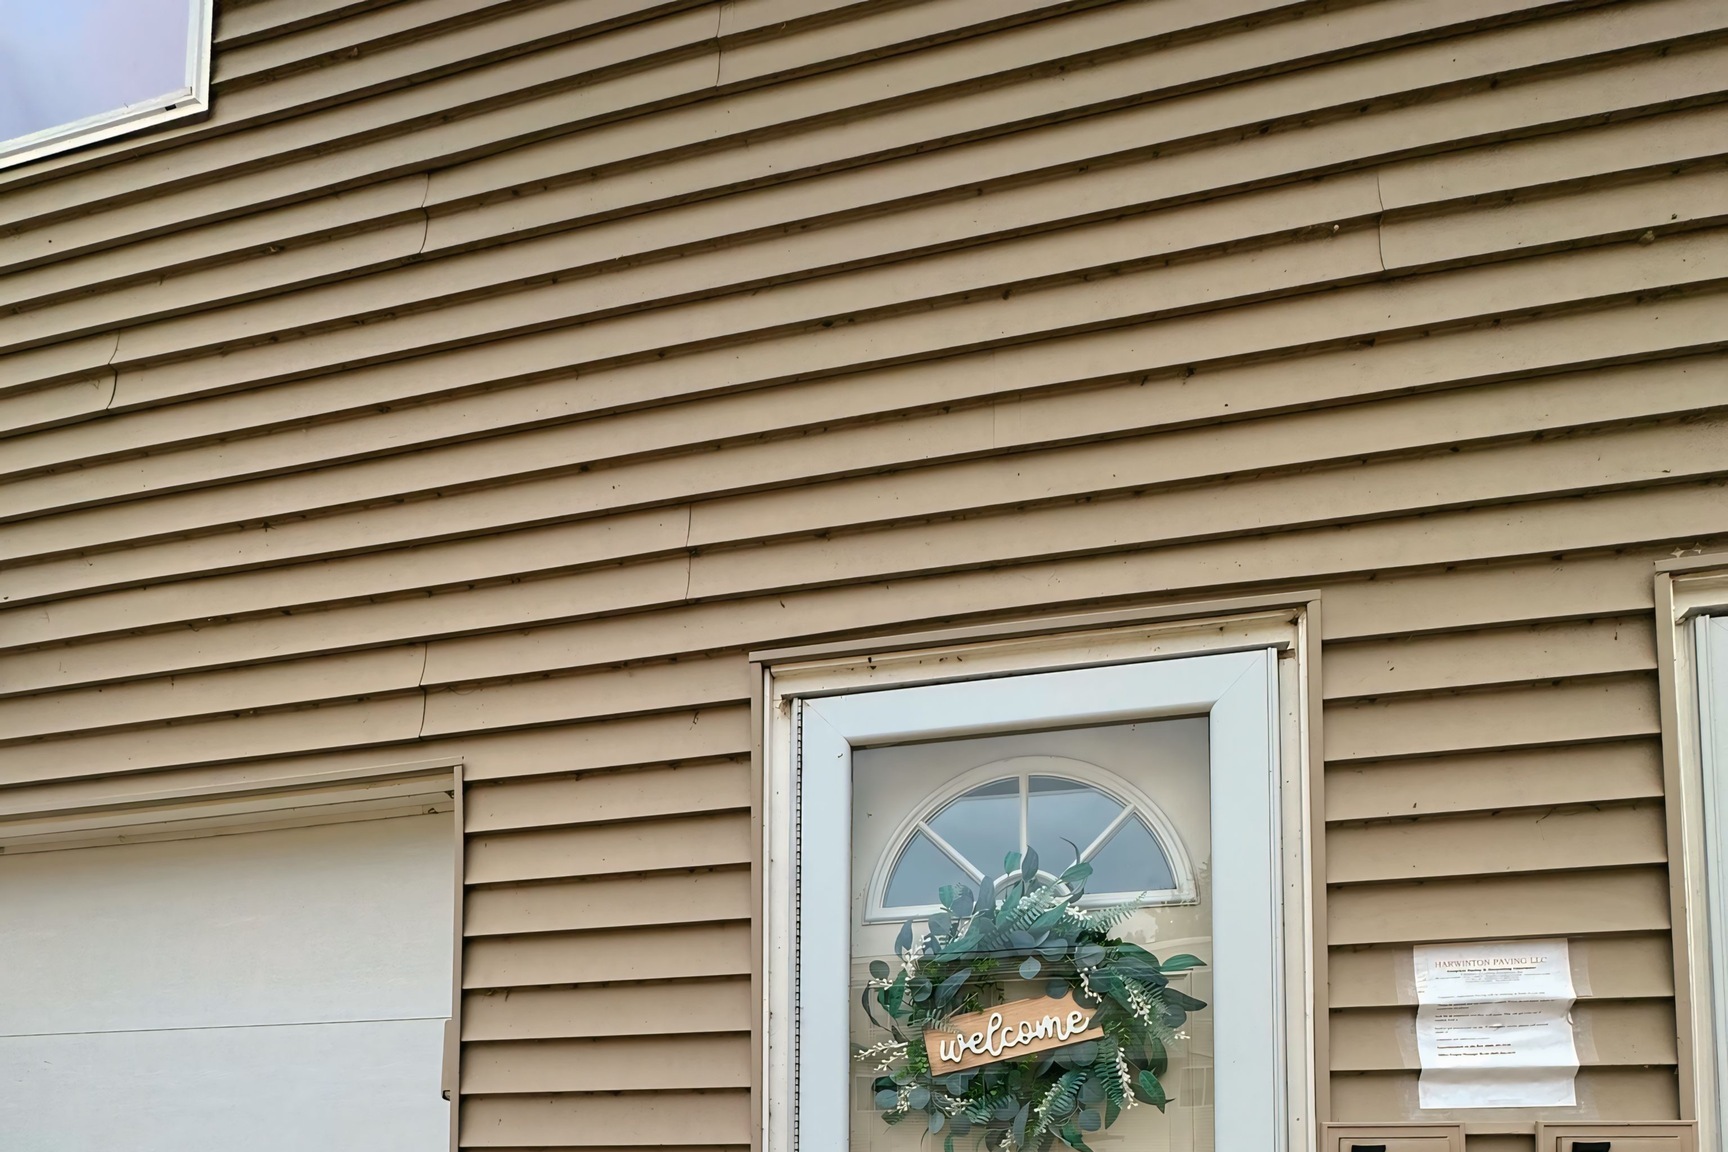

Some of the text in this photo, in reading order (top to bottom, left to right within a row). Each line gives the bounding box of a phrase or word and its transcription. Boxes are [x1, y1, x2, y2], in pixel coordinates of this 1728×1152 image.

[1435, 956, 1548, 968] HARWINTON PAVING LLC
[940, 1011, 1090, 1063] welcome
